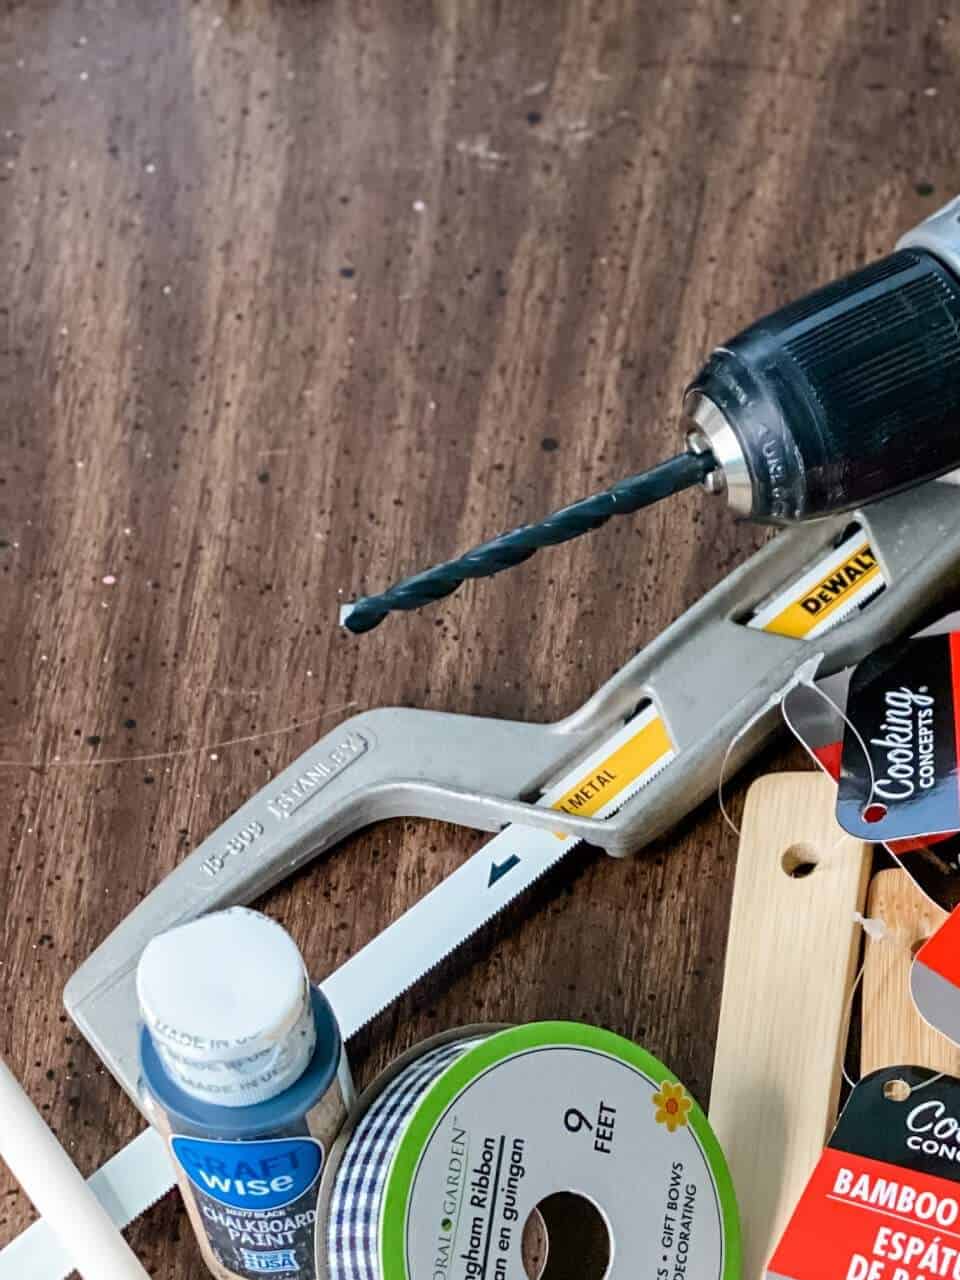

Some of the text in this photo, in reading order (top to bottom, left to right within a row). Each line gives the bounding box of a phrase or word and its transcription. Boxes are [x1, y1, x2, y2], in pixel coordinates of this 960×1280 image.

[870, 687, 934, 799] Cooking
[918, 708, 935, 789] CONCEPTS
[564, 1107, 593, 1133] 9
[594, 1101, 617, 1154] FEET
[443, 1127, 467, 1216] GARDEN
[470, 1137, 495, 1209] Ribbon
[501, 1137, 526, 1221] guingan
[667, 1161, 685, 1212] BOWS
[832, 1167, 959, 1227] BAMBOO
[203, 1205, 317, 1233] CHALKBOARD
[227, 1228, 297, 1247] PAINT
[499, 1226, 511, 1251] en
[661, 1213, 677, 1249] GIFT
